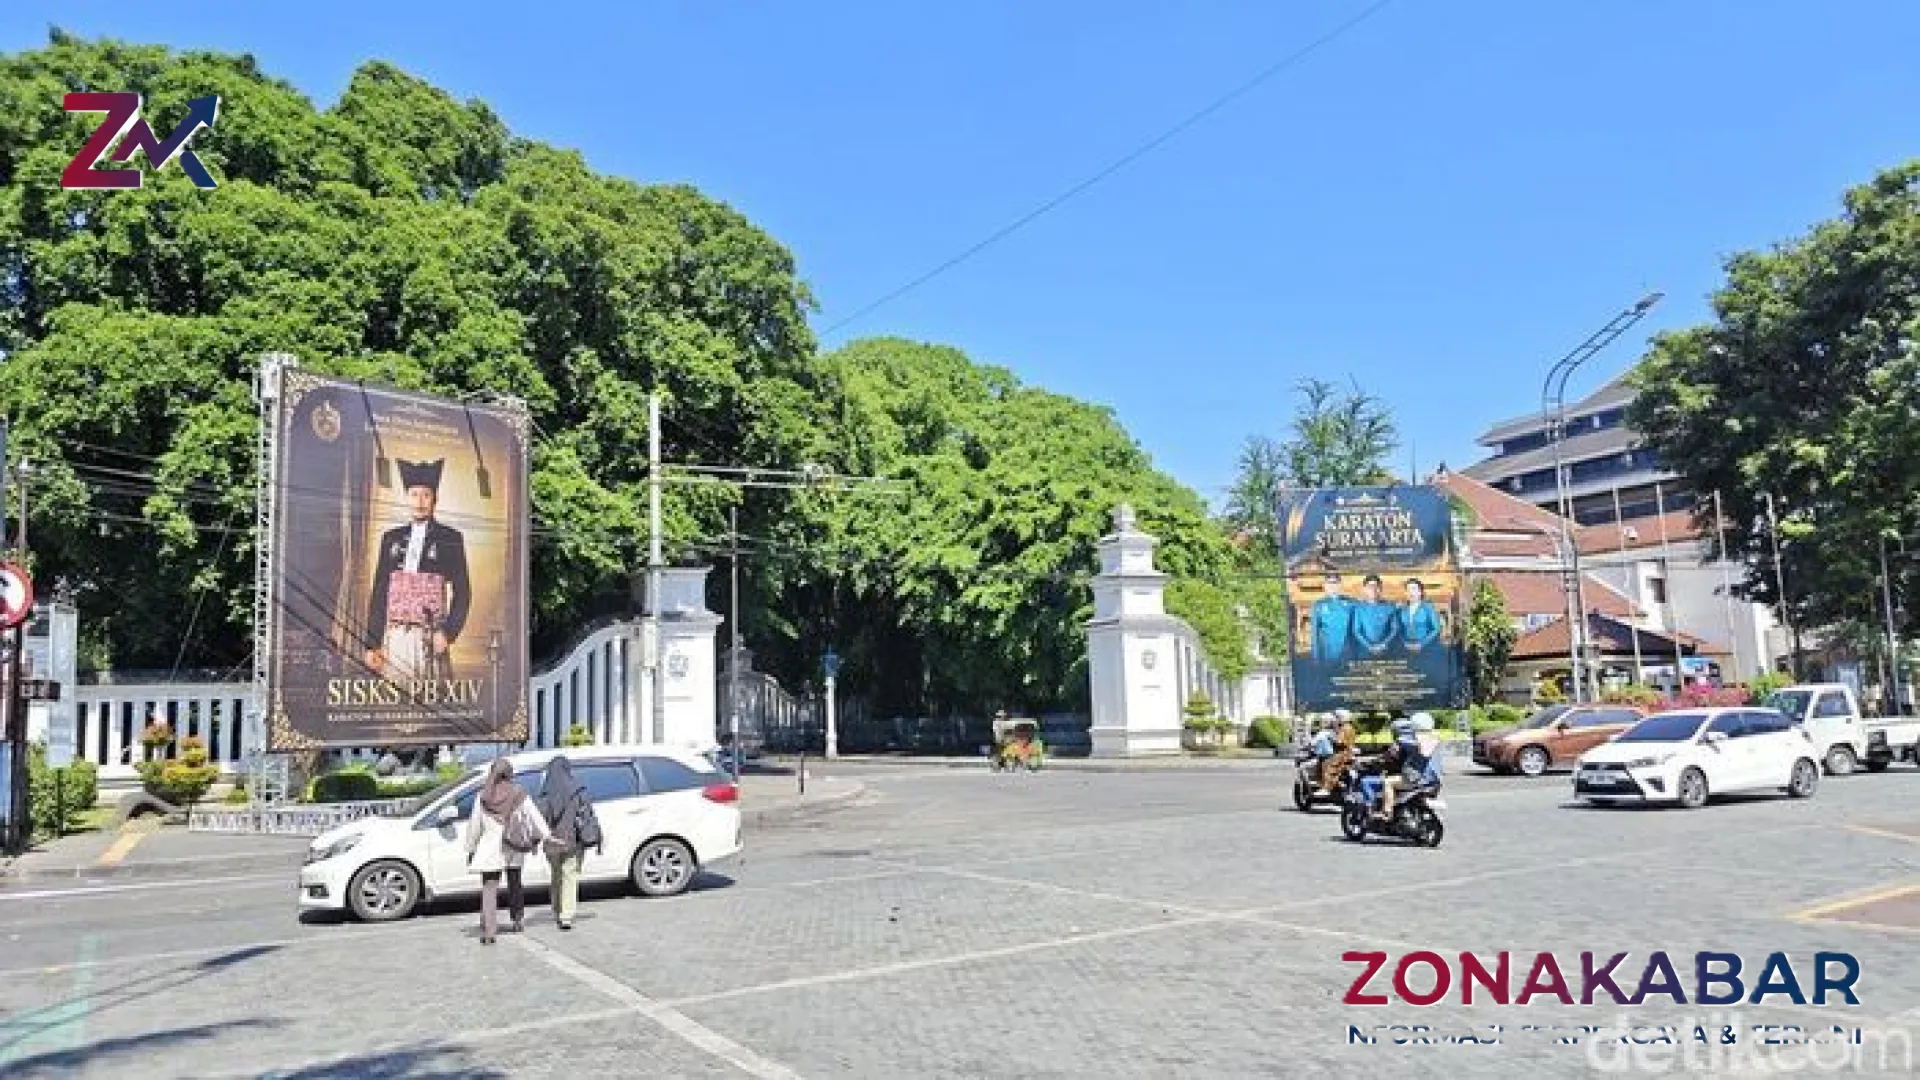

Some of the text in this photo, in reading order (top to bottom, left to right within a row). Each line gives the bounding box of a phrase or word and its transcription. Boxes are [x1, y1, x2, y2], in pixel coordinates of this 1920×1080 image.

[328, 679, 484, 705] SISKS PB XIV
